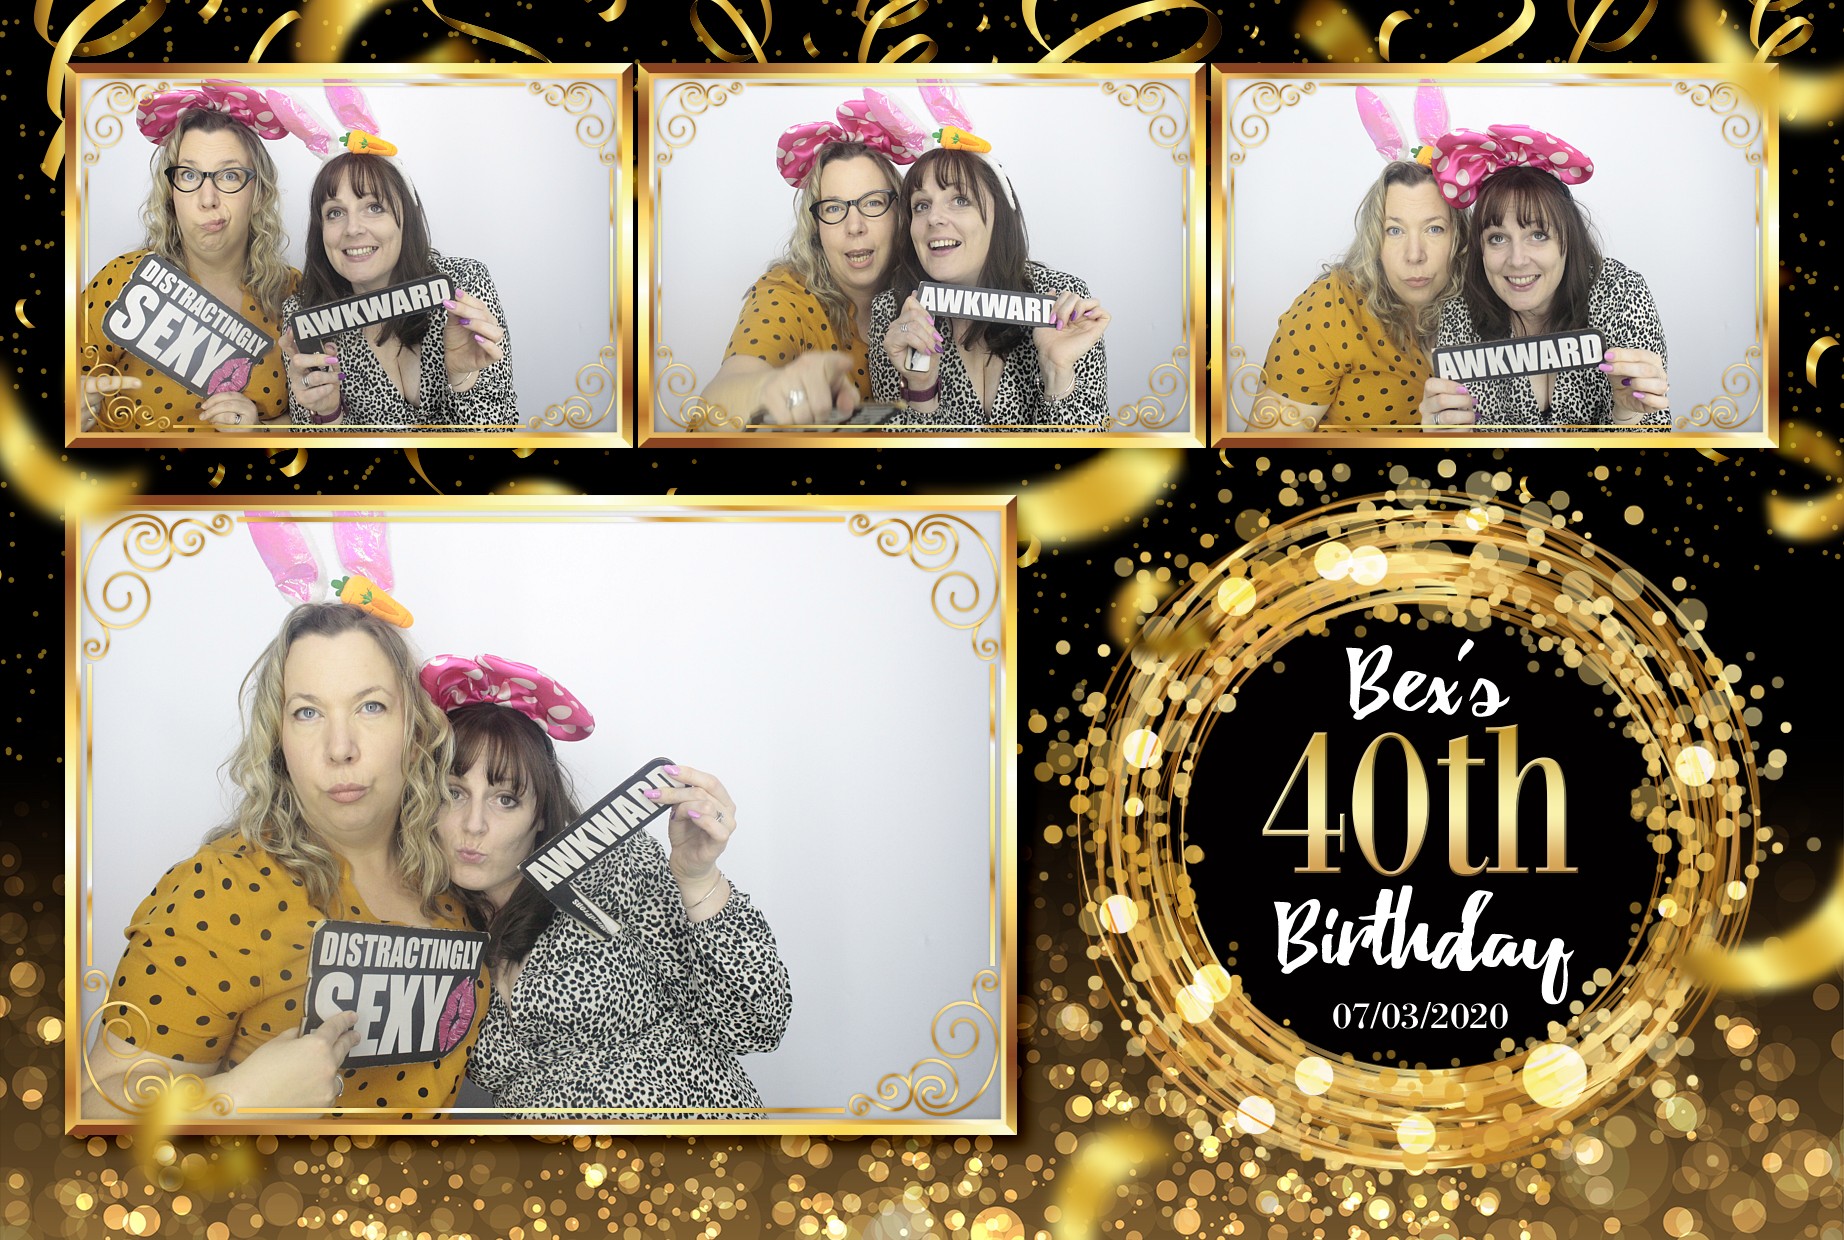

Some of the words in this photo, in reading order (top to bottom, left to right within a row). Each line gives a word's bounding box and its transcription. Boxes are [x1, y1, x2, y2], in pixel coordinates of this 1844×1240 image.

[109, 284, 237, 389] SEXY
[139, 258, 268, 357] DISTRACTINGLY
[294, 278, 451, 340] AWKWARD
[1437, 333, 1602, 381] AWKWARD
[318, 931, 483, 970] DISTRACTINGLY
[312, 971, 454, 1058] SEXY
